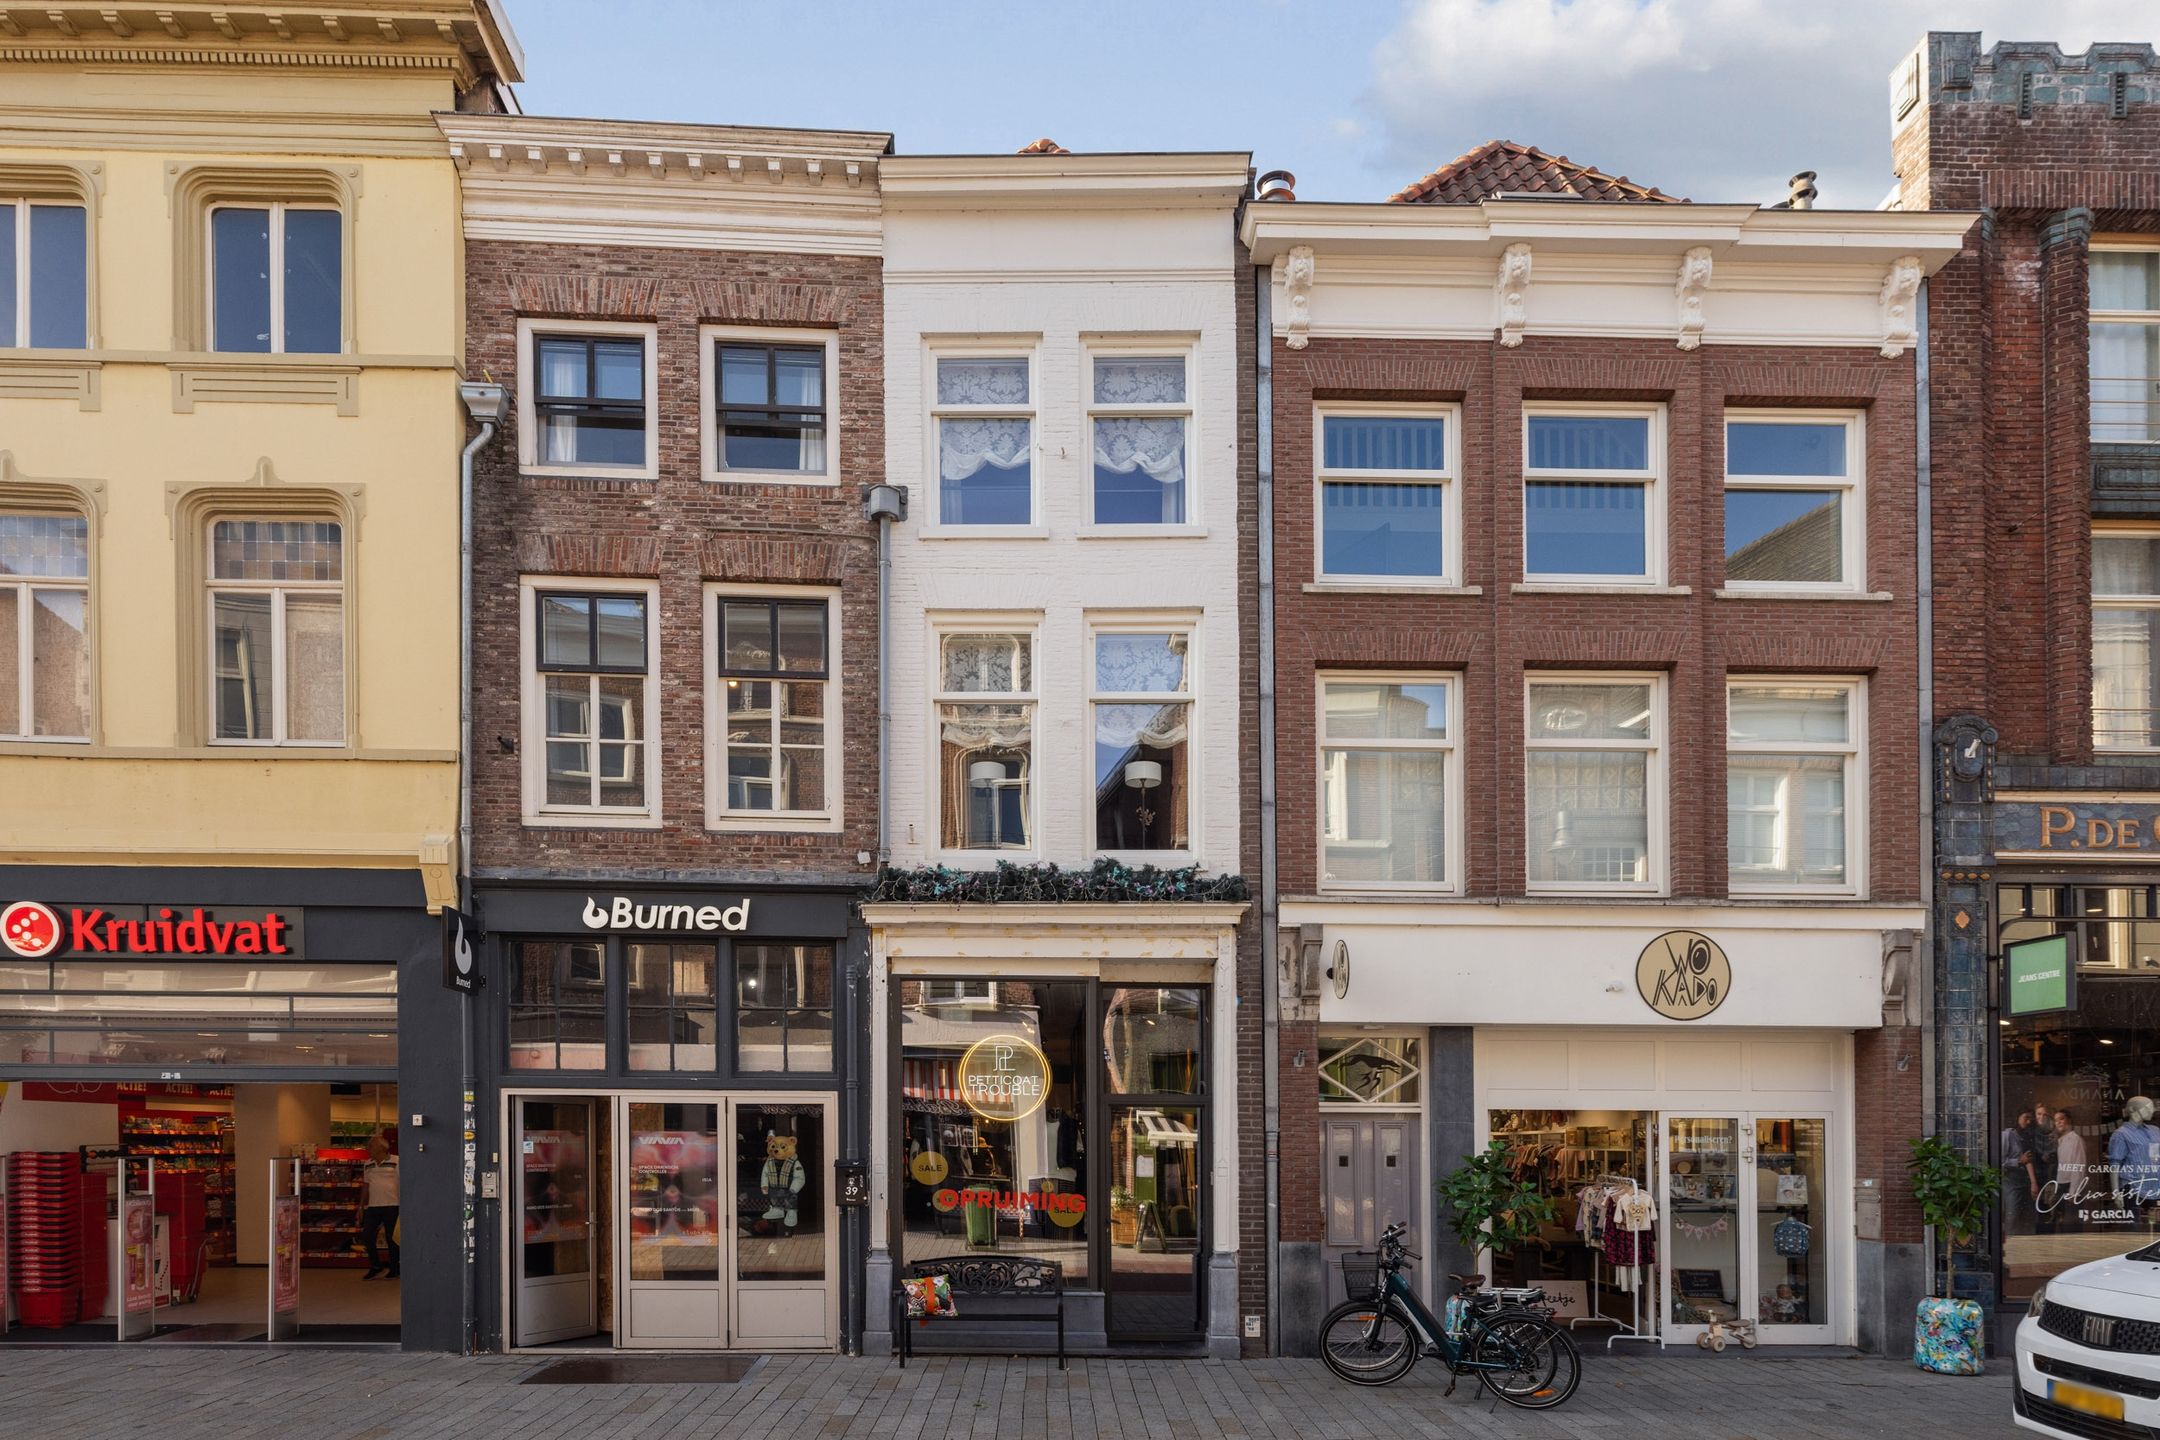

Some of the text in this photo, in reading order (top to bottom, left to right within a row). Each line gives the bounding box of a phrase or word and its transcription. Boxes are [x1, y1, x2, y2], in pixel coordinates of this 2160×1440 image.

[2087, 819, 2140, 848] DE
[610, 896, 751, 931] Burned
[71, 908, 287, 954] Kruidvat
[1664, 938, 1711, 975] WO
[456, 976, 471, 988] Burned
[2018, 969, 2061, 983] JEANS CENTRE
[1652, 969, 1718, 1006] KADO
[968, 1075, 1039, 1085] PETTICOAT
[165, 1083, 193, 1094] ACTIE!
[968, 1084, 1040, 1096] TROUBLE
[2058, 1164, 2160, 1173] MEET GARCIA'S NEW
[845, 1187, 858, 1195] 39
[939, 1189, 1087, 1212] OPRUIMING
[2091, 1209, 2135, 1219] GARCIA
[2083, 1315, 2115, 1346] FIAT
